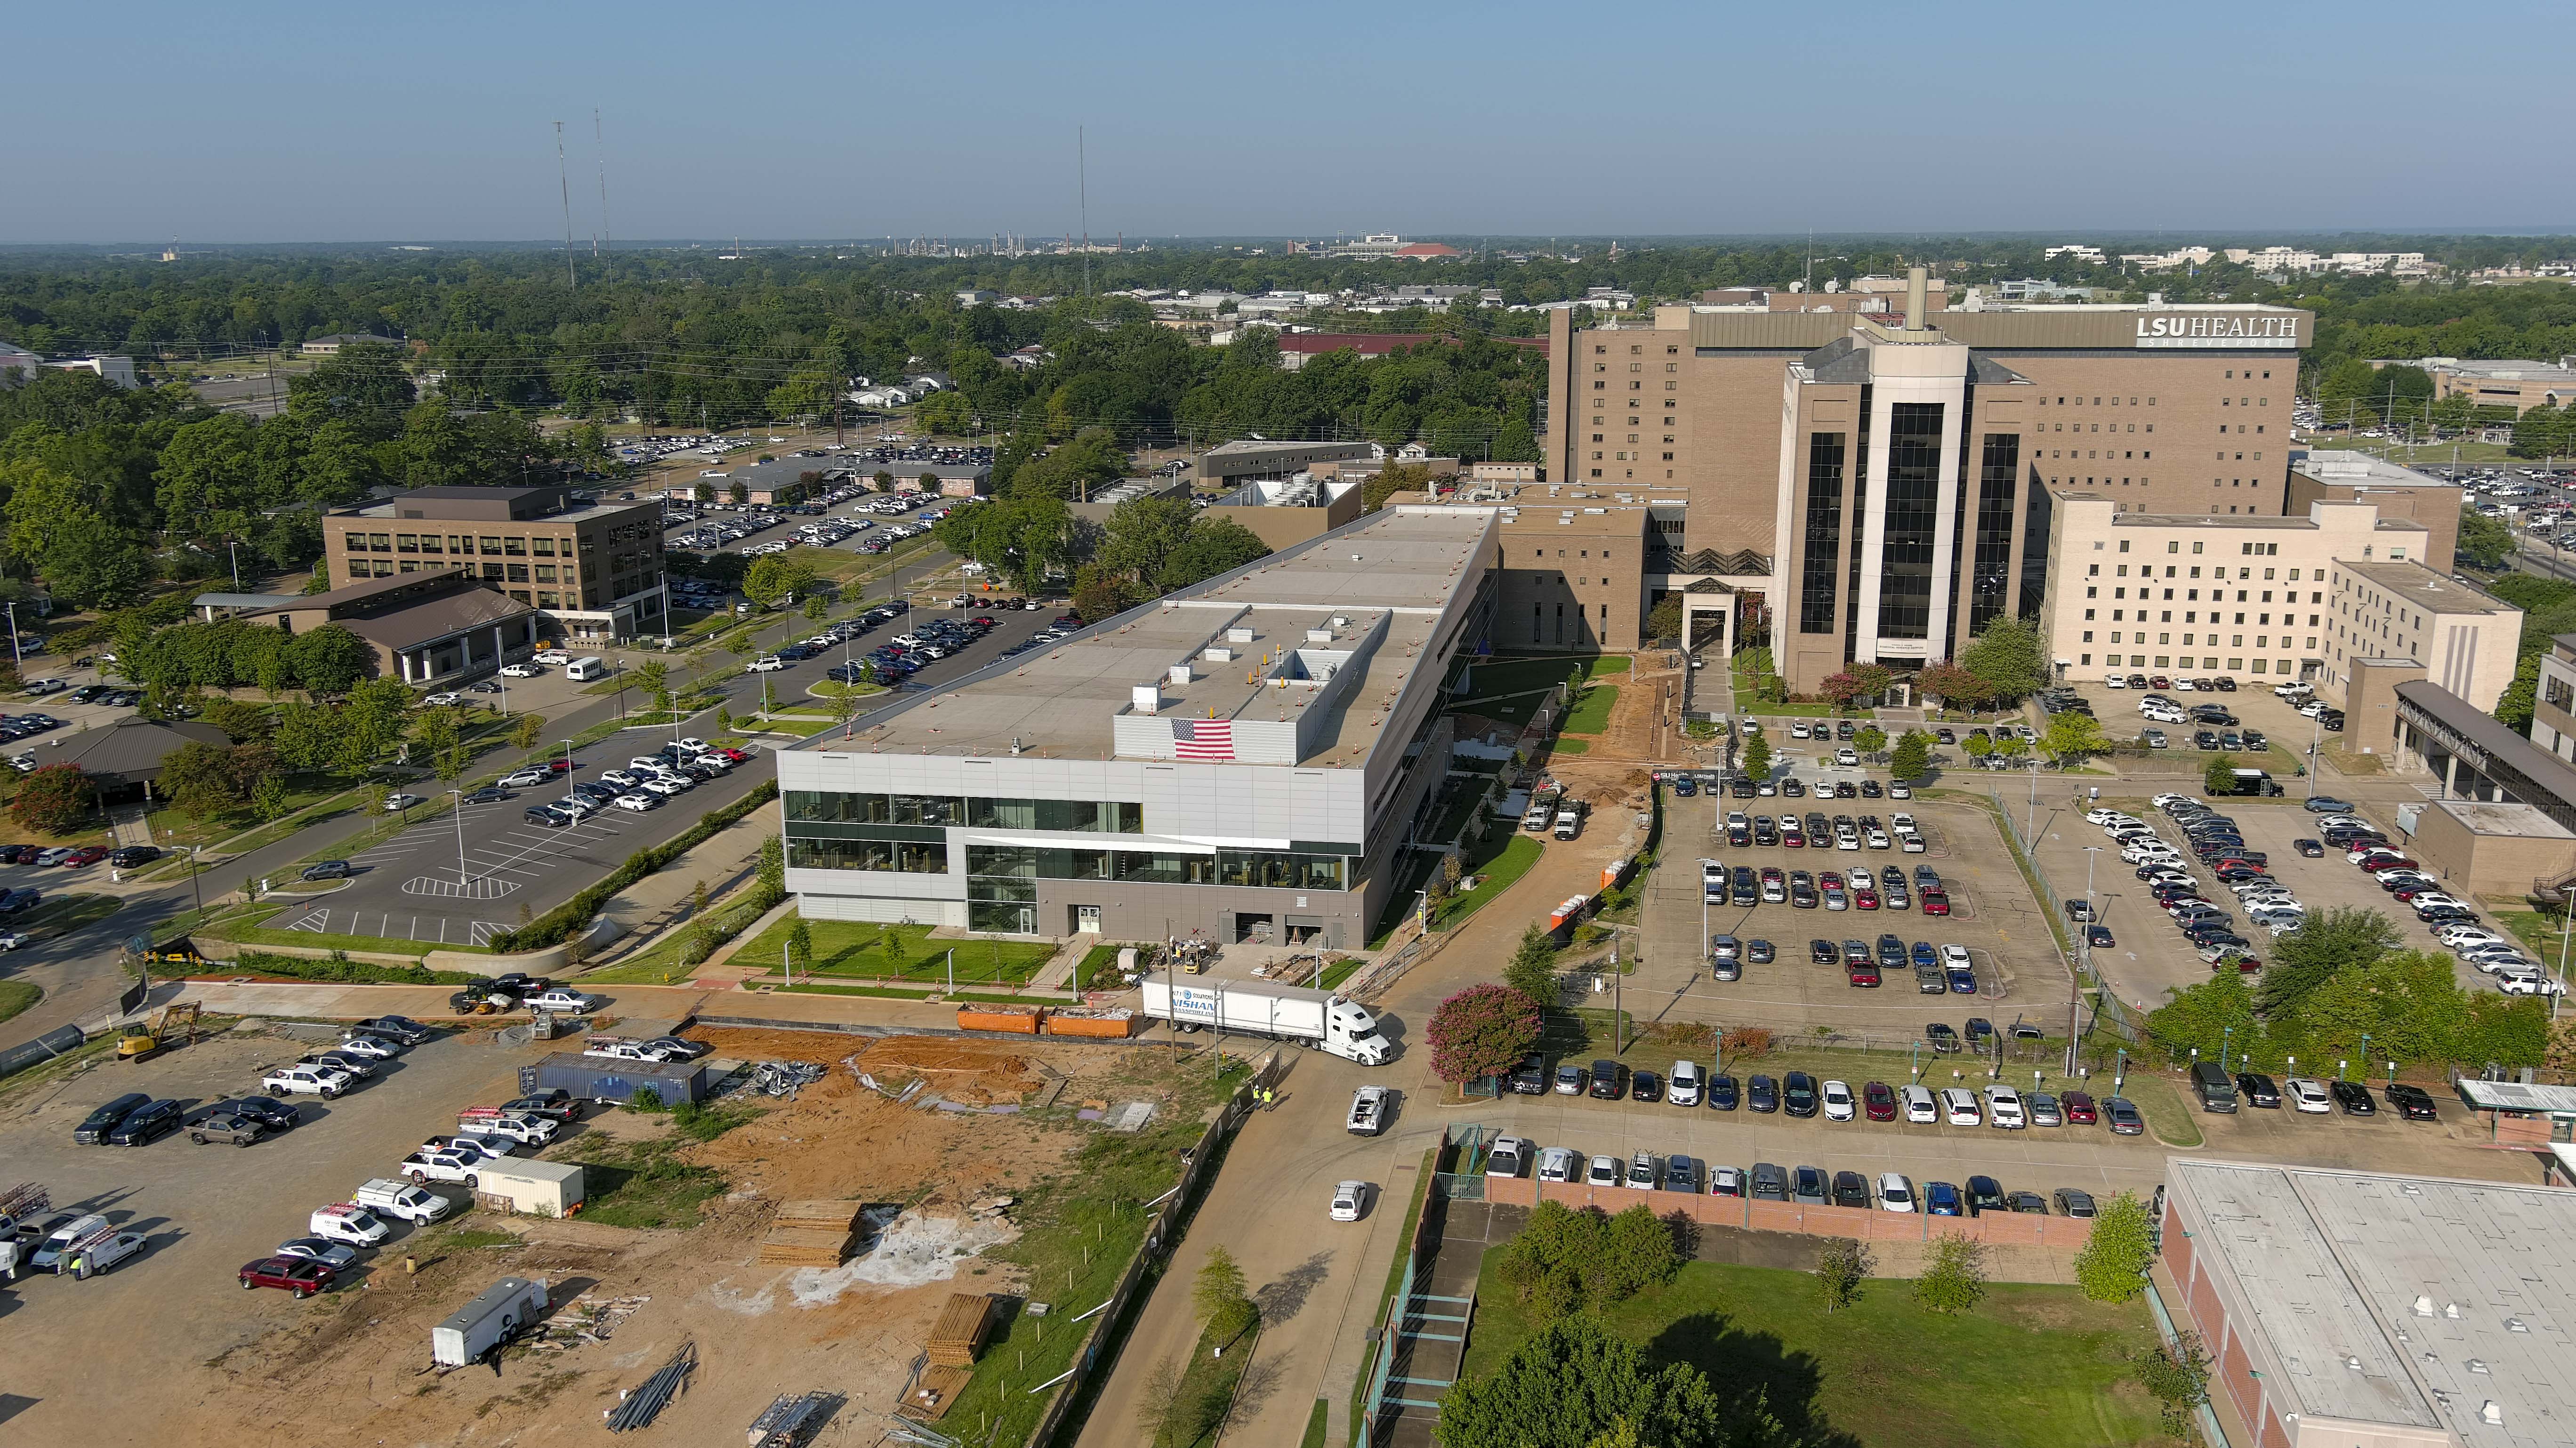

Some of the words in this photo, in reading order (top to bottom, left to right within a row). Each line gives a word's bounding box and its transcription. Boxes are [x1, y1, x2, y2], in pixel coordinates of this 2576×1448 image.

[2137, 318, 2186, 337] LSU
[2189, 317, 2299, 338] HEALTH
[2148, 338, 2285, 347] SHREVEPORT
